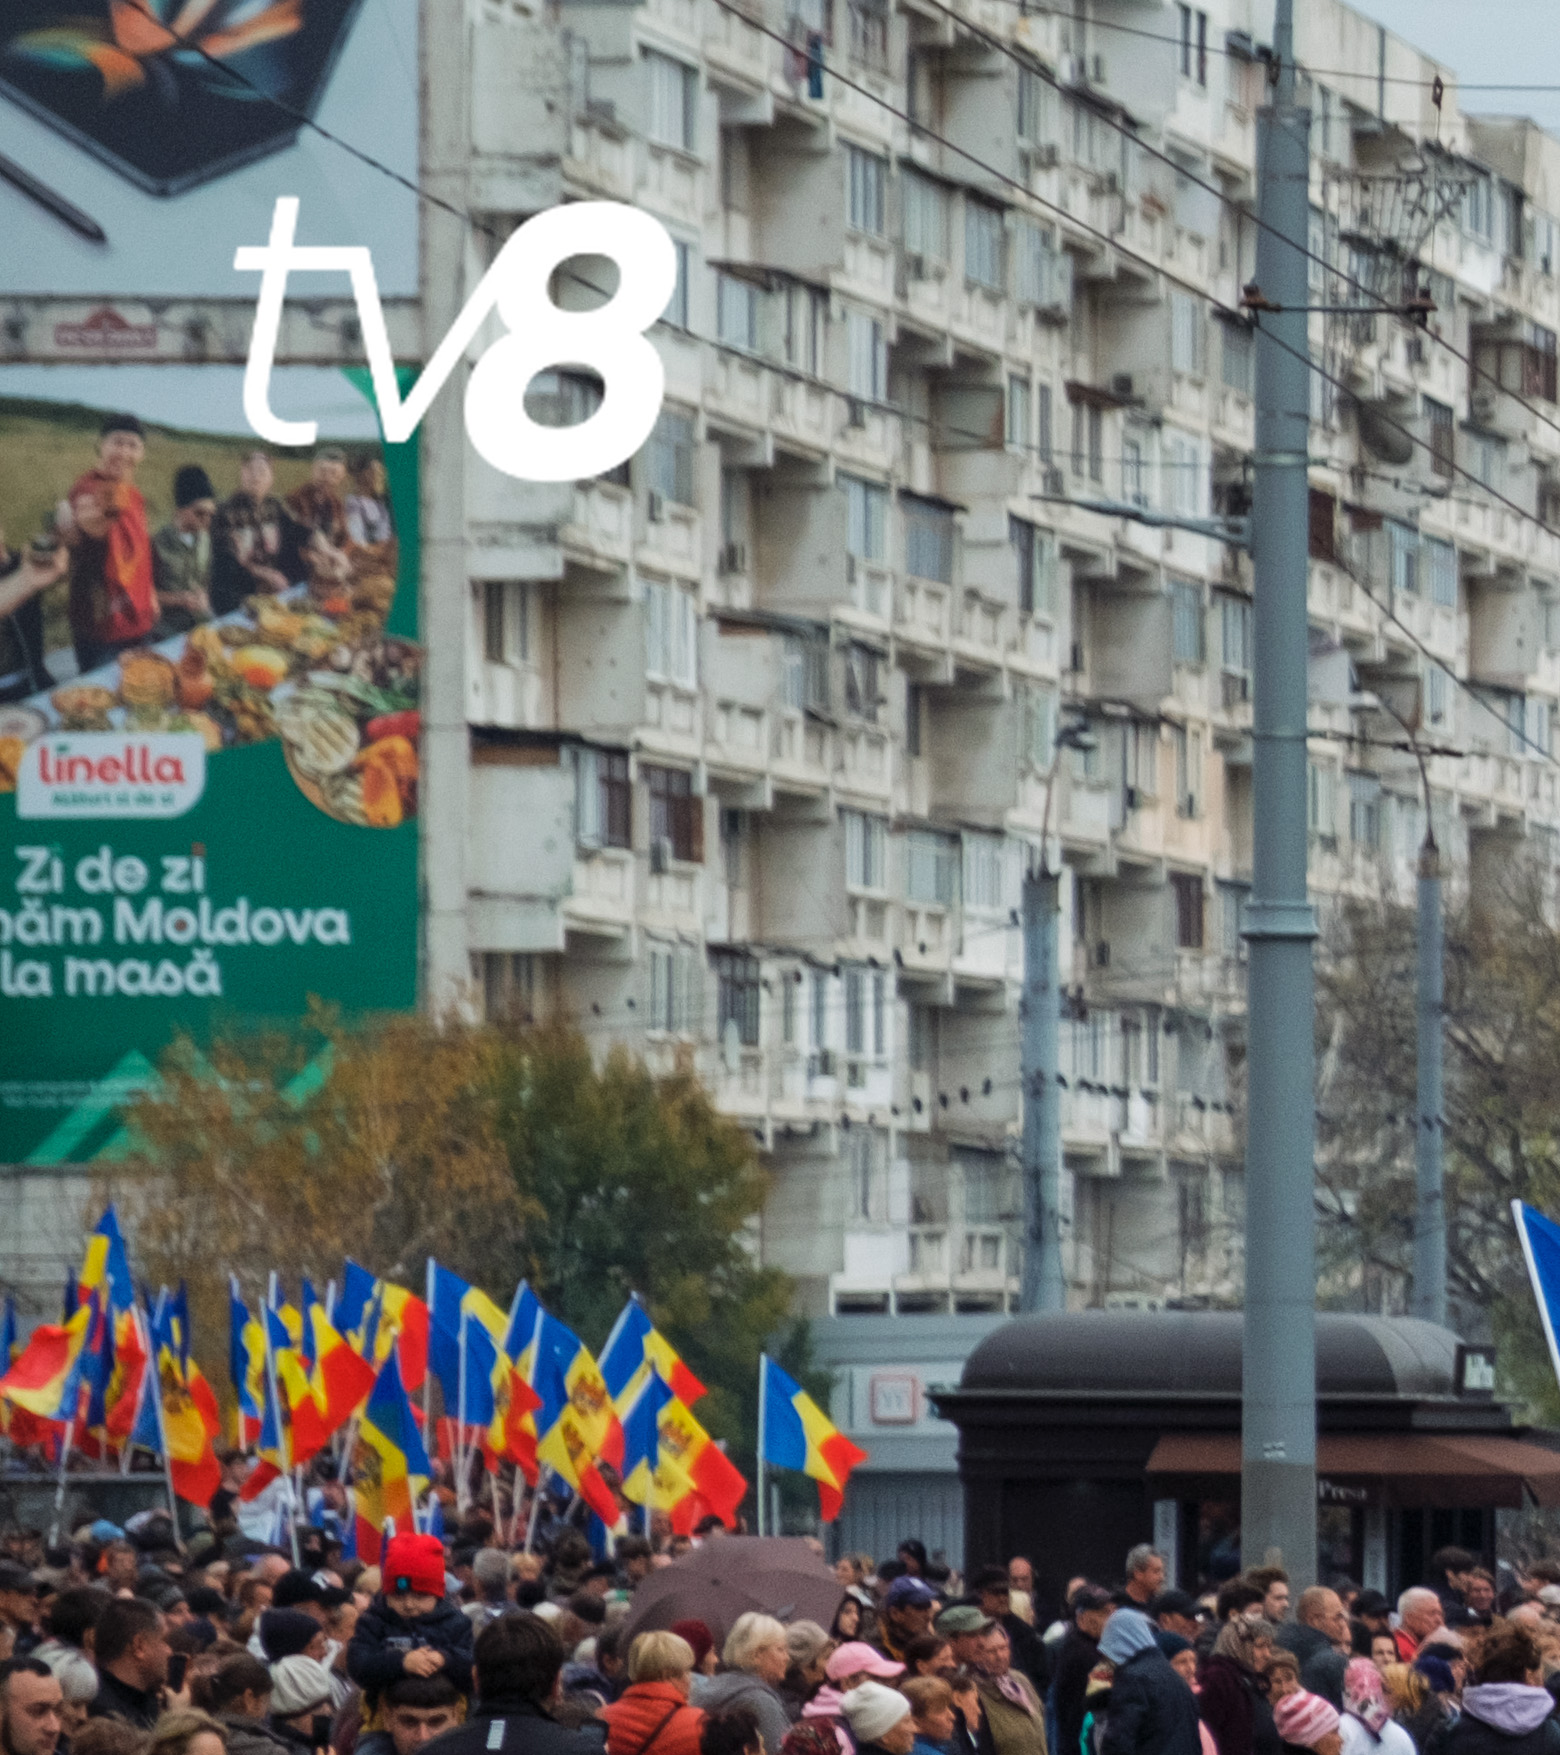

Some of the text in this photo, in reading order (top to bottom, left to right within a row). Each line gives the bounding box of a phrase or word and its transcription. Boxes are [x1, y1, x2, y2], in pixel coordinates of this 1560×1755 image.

[38, 744, 185, 785] linella
[15, 841, 205, 894] Zi de zi
[114, 897, 351, 945] Moldova
[64, 948, 223, 997] masă
